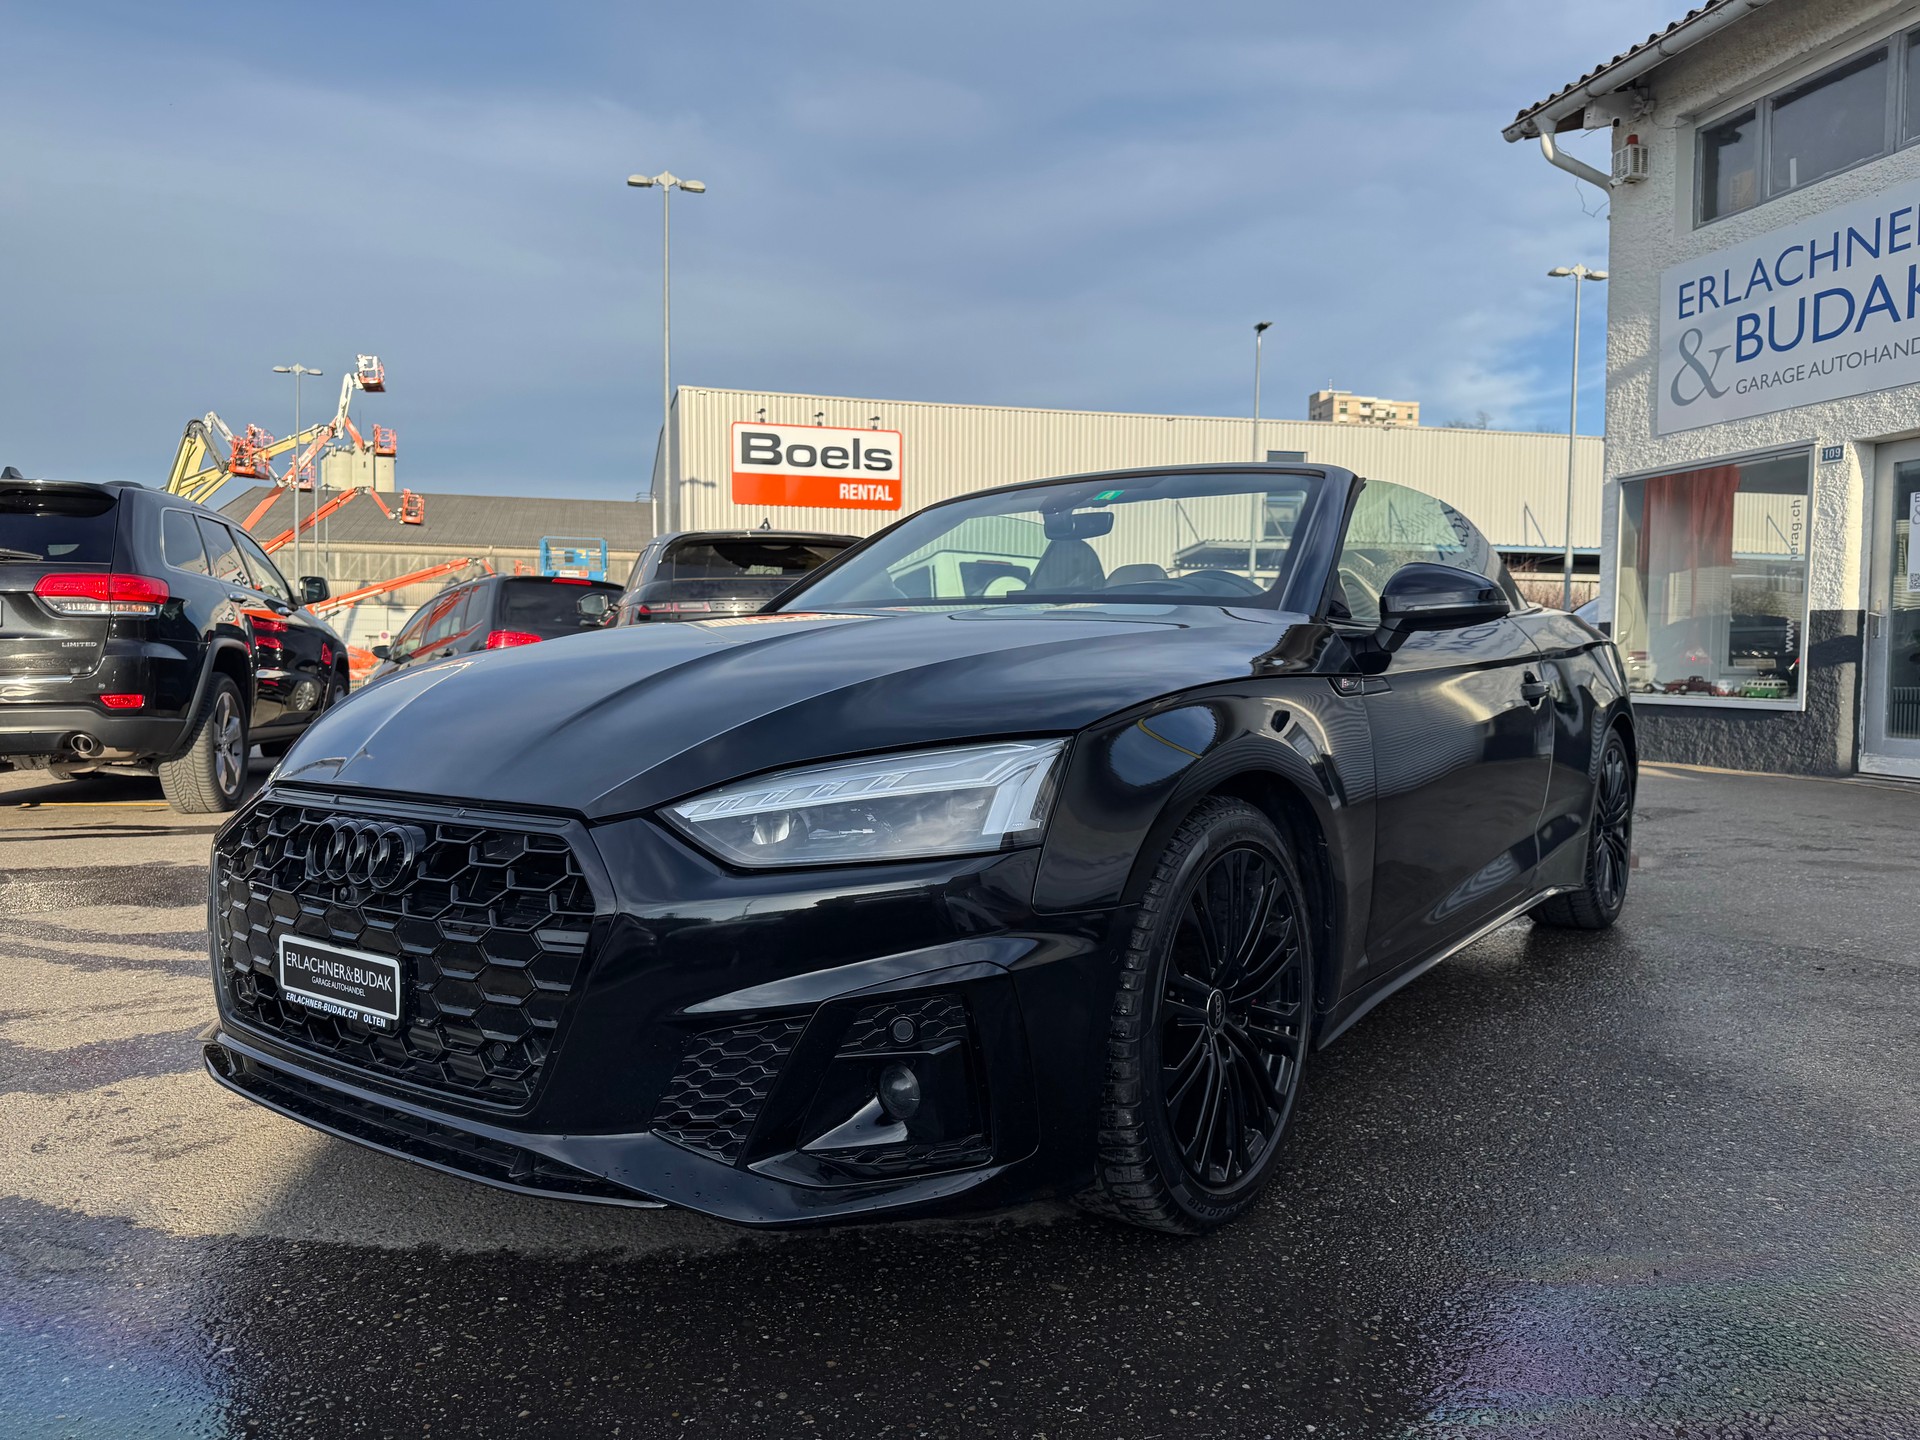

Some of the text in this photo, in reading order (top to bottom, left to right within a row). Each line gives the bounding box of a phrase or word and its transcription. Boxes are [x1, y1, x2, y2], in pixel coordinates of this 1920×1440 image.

[1678, 203, 1920, 320] ERLACHNE
[1671, 328, 1731, 407] &
[1736, 365, 1805, 394] GARAGE
[741, 432, 893, 471] Boels
[1825, 447, 1841, 459] 109
[839, 483, 893, 501] RENTAL
[312, 976, 365, 997] GARAGE AUTOHANDEL
[286, 992, 386, 1027] ERLACHNER-BUDAK.CH OLTEN
